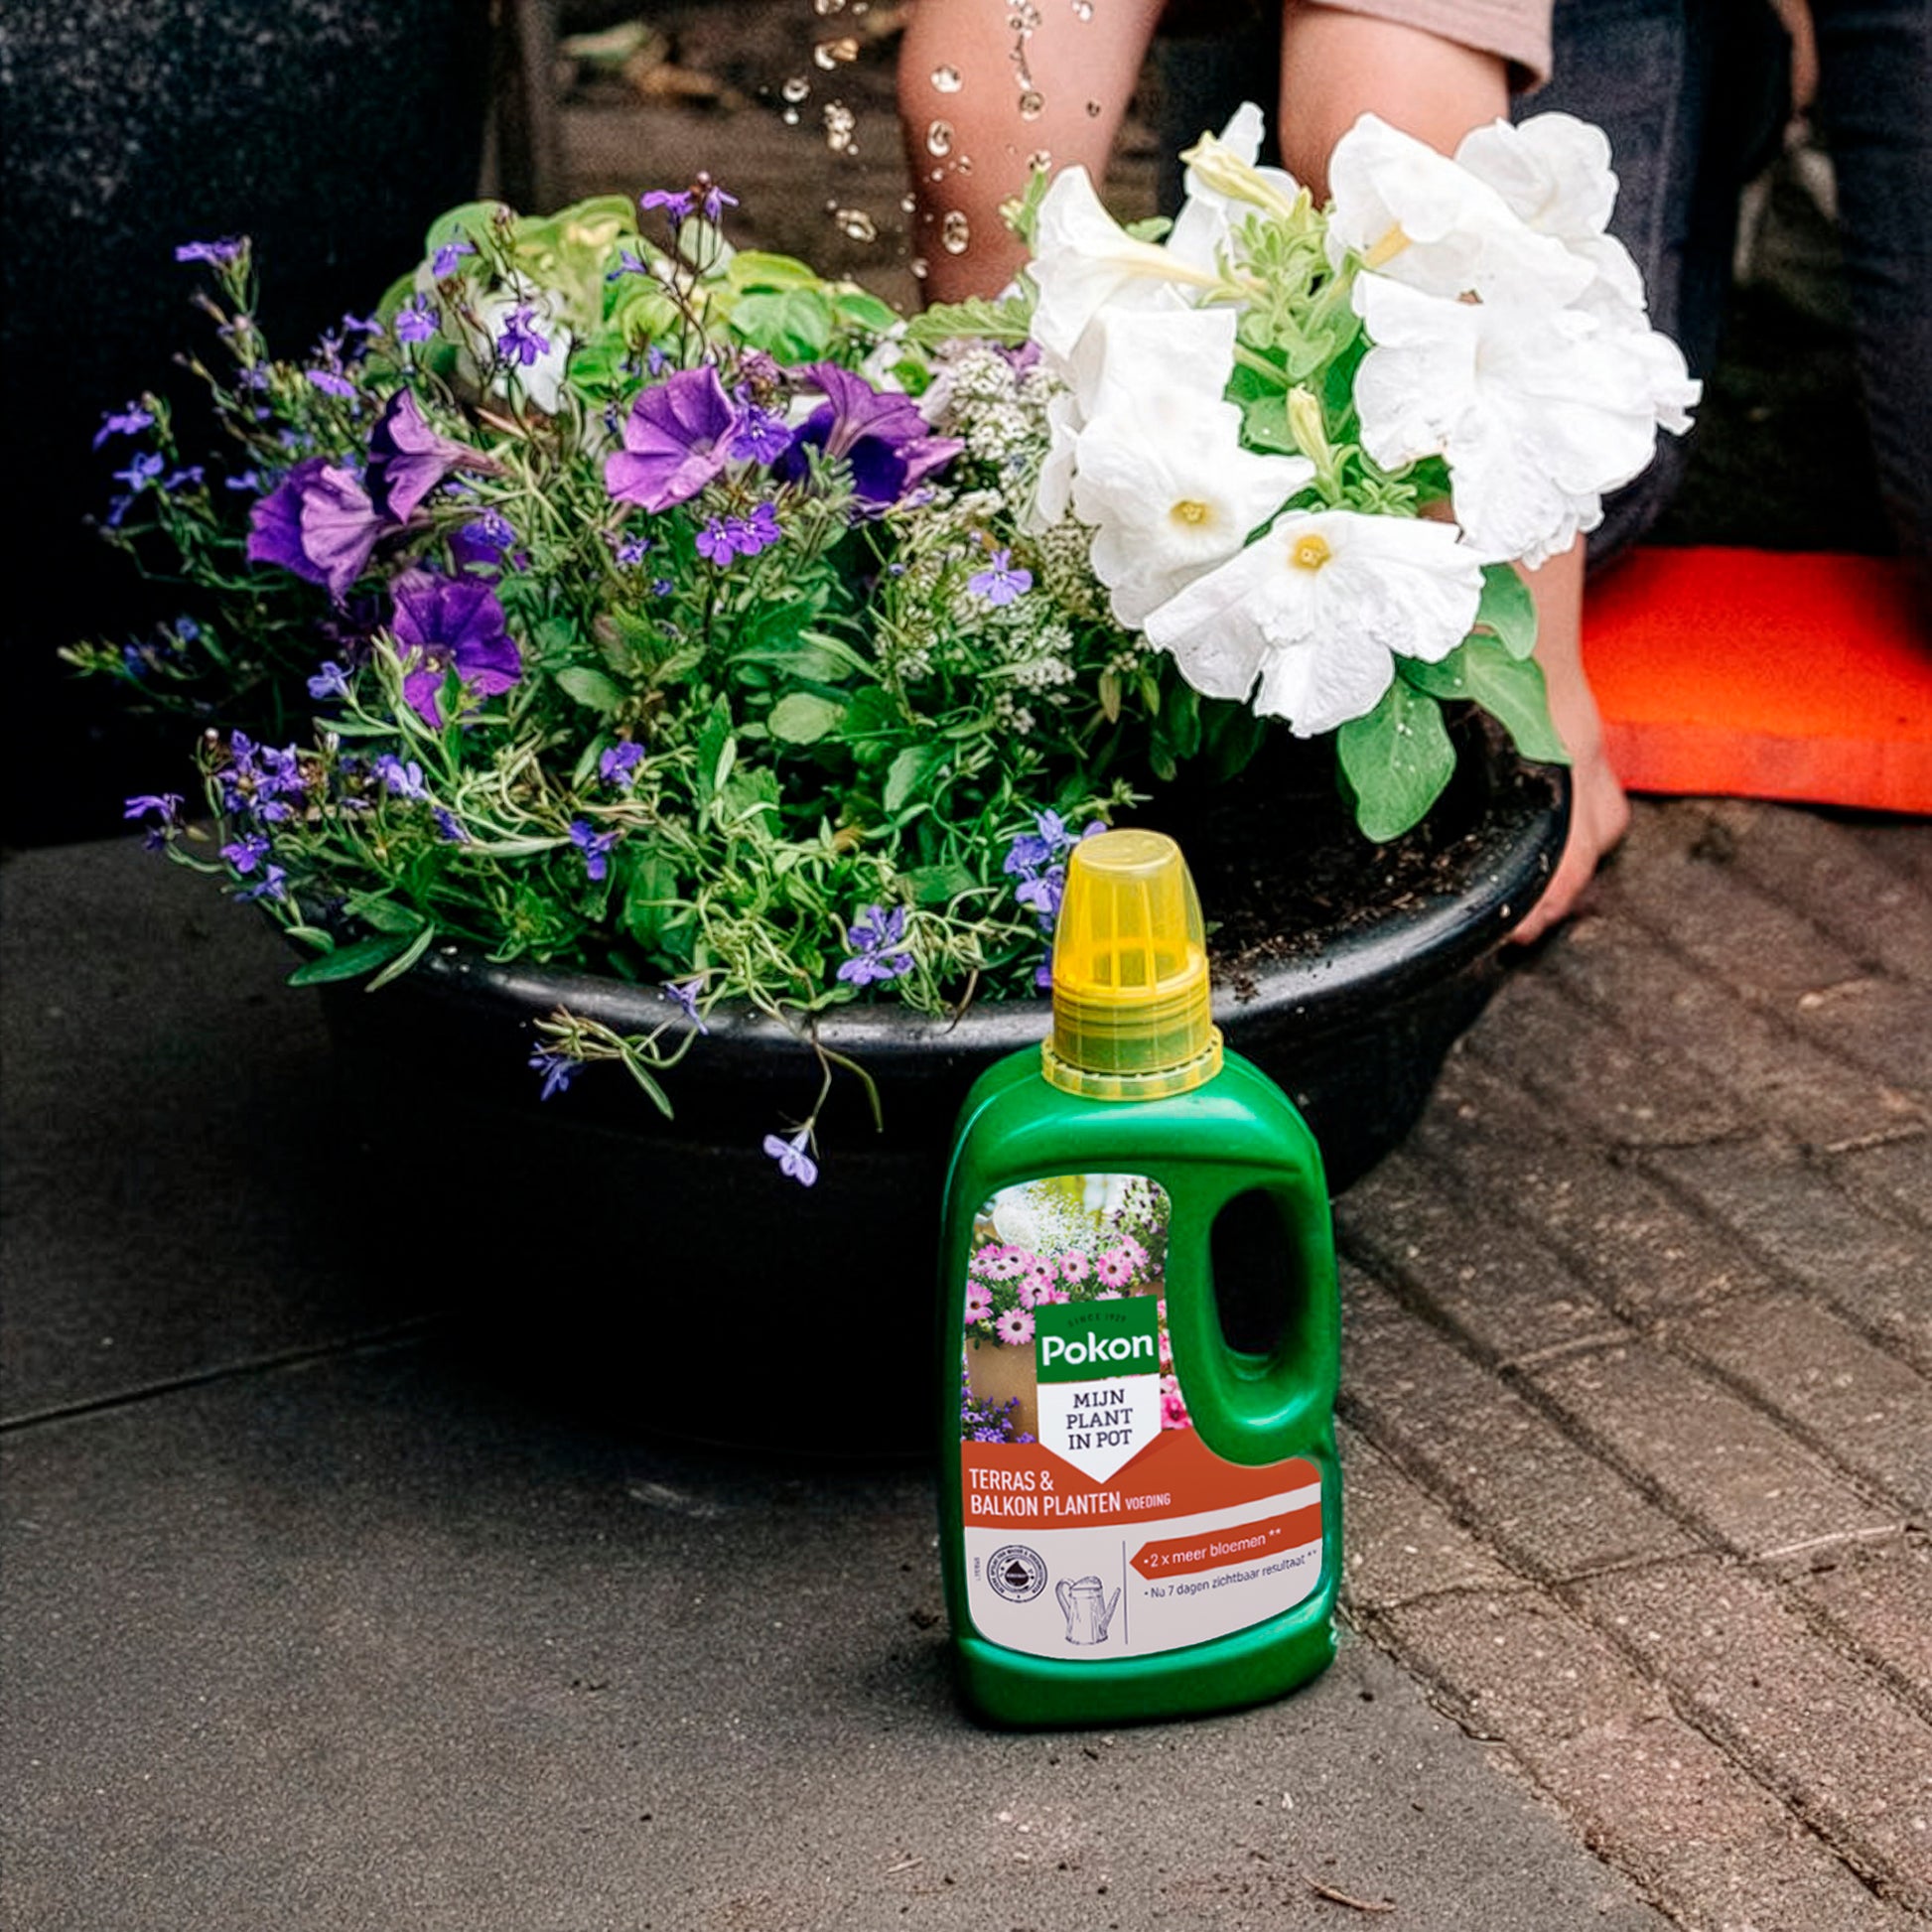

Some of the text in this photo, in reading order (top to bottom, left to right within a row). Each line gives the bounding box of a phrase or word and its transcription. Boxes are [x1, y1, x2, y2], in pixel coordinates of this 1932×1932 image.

[1042, 1331, 1155, 1366] Pokon
[1073, 1389, 1125, 1409] MIJN
[1066, 1408, 1134, 1430] PLANT
[1068, 1429, 1133, 1449] IN POT
[969, 1468, 1054, 1491] TERRAS &
[971, 1491, 1172, 1516] BALKON PLANTEN VOEDING
[1162, 1554, 1171, 1566] x
[1173, 1548, 1207, 1564] meer
[1210, 1534, 1266, 1558] bloemen
[1176, 1580, 1209, 1595] dagen
[1212, 1568, 1260, 1588] zichtbaar
[1262, 1554, 1306, 1576] resultaat
